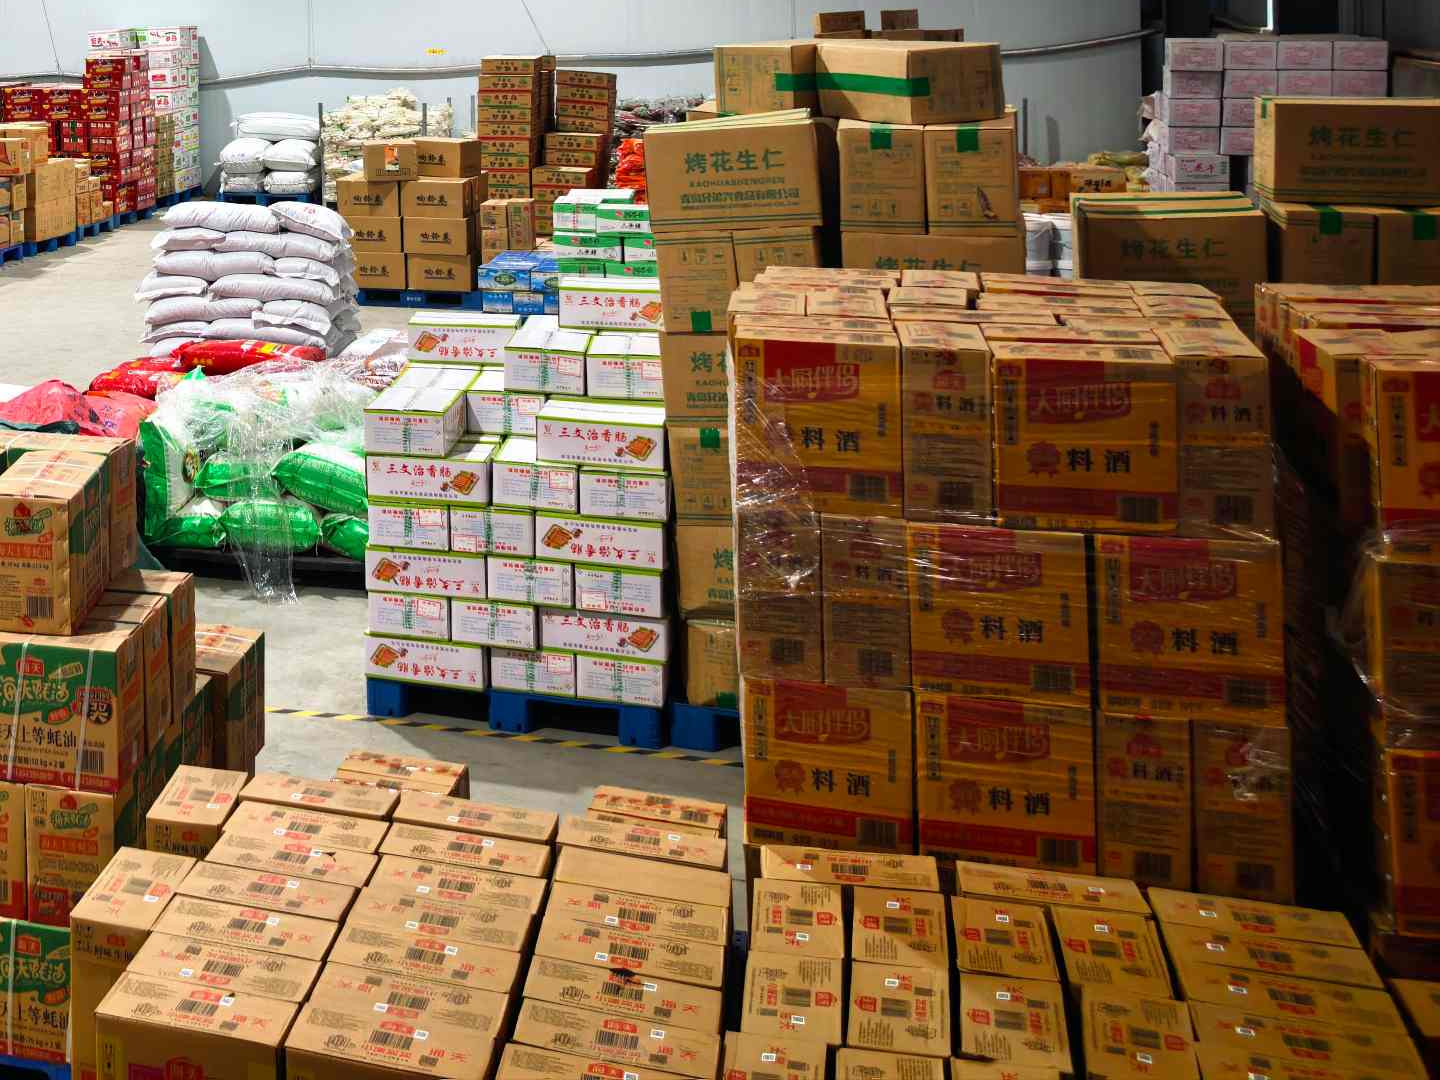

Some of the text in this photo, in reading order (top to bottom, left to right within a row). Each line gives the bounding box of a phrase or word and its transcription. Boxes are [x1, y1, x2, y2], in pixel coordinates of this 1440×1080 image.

[685, 147, 786, 175] 烤花生仁
[558, 427, 628, 444] 三文治香肠
[800, 425, 860, 453] 料酒
[386, 463, 452, 481] 三文治香肠
[1067, 447, 1132, 475] 料酒
[811, 767, 871, 798] 料酒
[987, 786, 1051, 816] 料酒
